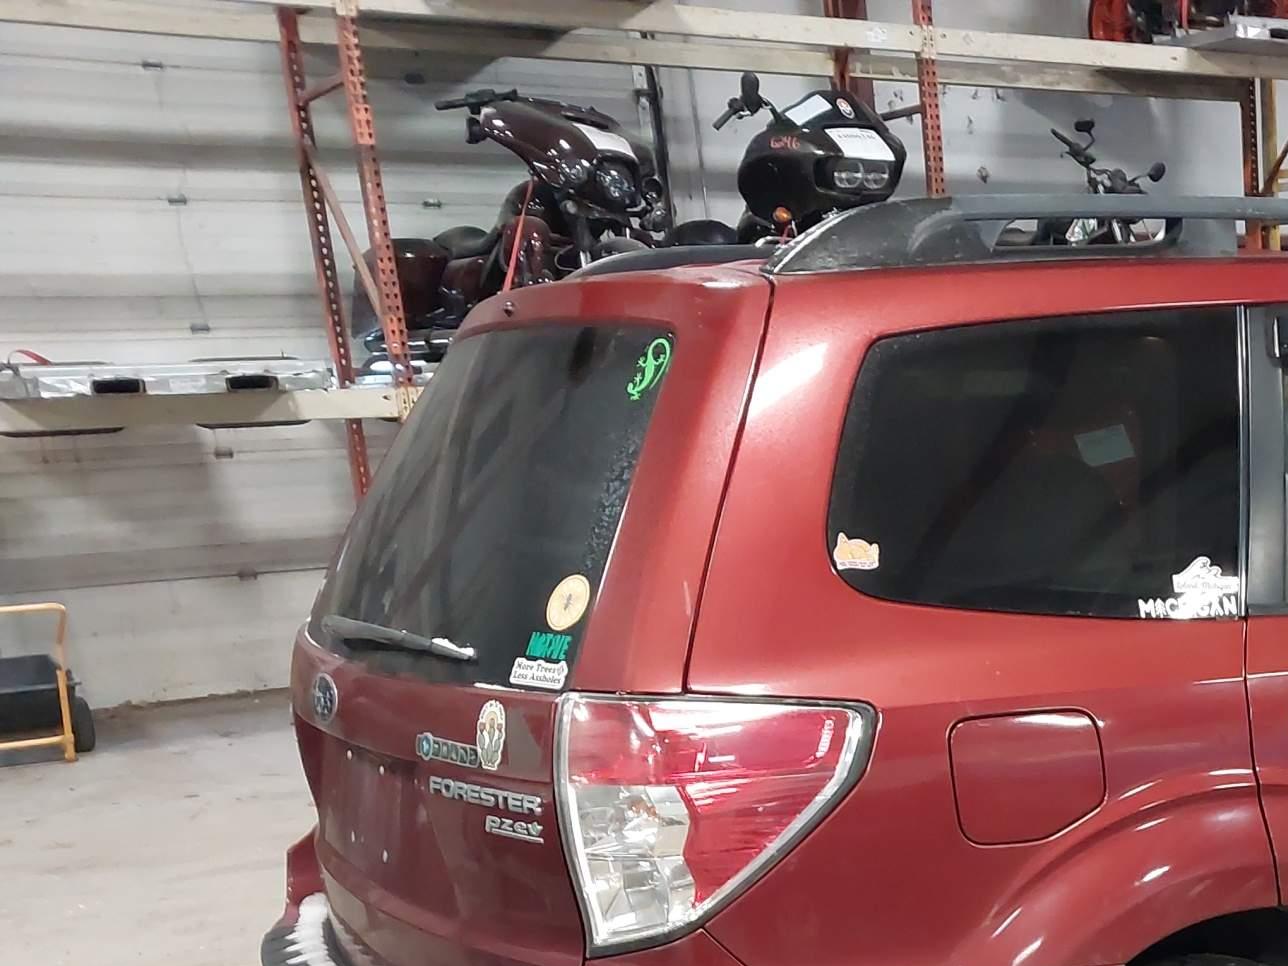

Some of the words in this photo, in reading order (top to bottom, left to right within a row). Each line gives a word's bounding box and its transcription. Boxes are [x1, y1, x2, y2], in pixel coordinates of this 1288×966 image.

[515, 660, 534, 671] More
[536, 663, 556, 674] Trees
[512, 670, 528, 681] Less
[529, 673, 562, 685] Assholes
[429, 775, 542, 816] FORESTER
